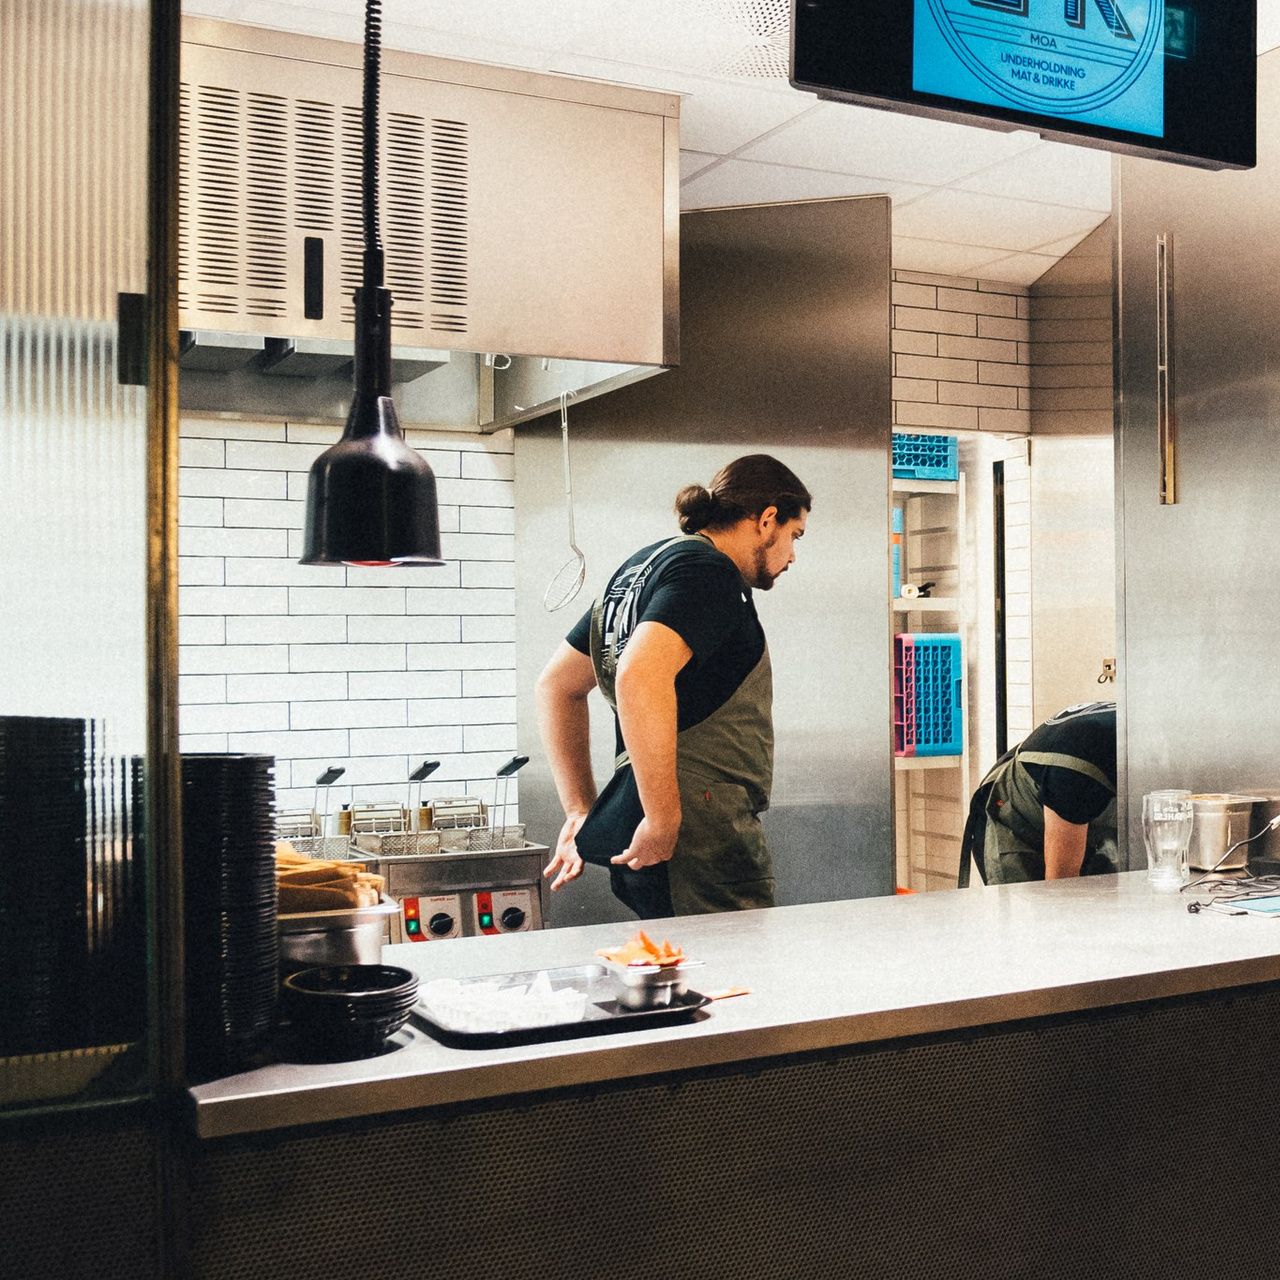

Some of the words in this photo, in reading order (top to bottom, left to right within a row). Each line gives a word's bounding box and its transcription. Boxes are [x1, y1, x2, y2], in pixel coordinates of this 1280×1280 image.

[1030, 32, 1058, 49] MOA
[1001, 52, 1087, 79] UNDERHOLDNING
[1011, 68, 1031, 81] MAT
[1032, 72, 1041, 84] &
[1042, 74, 1076, 91] DRIKKE
